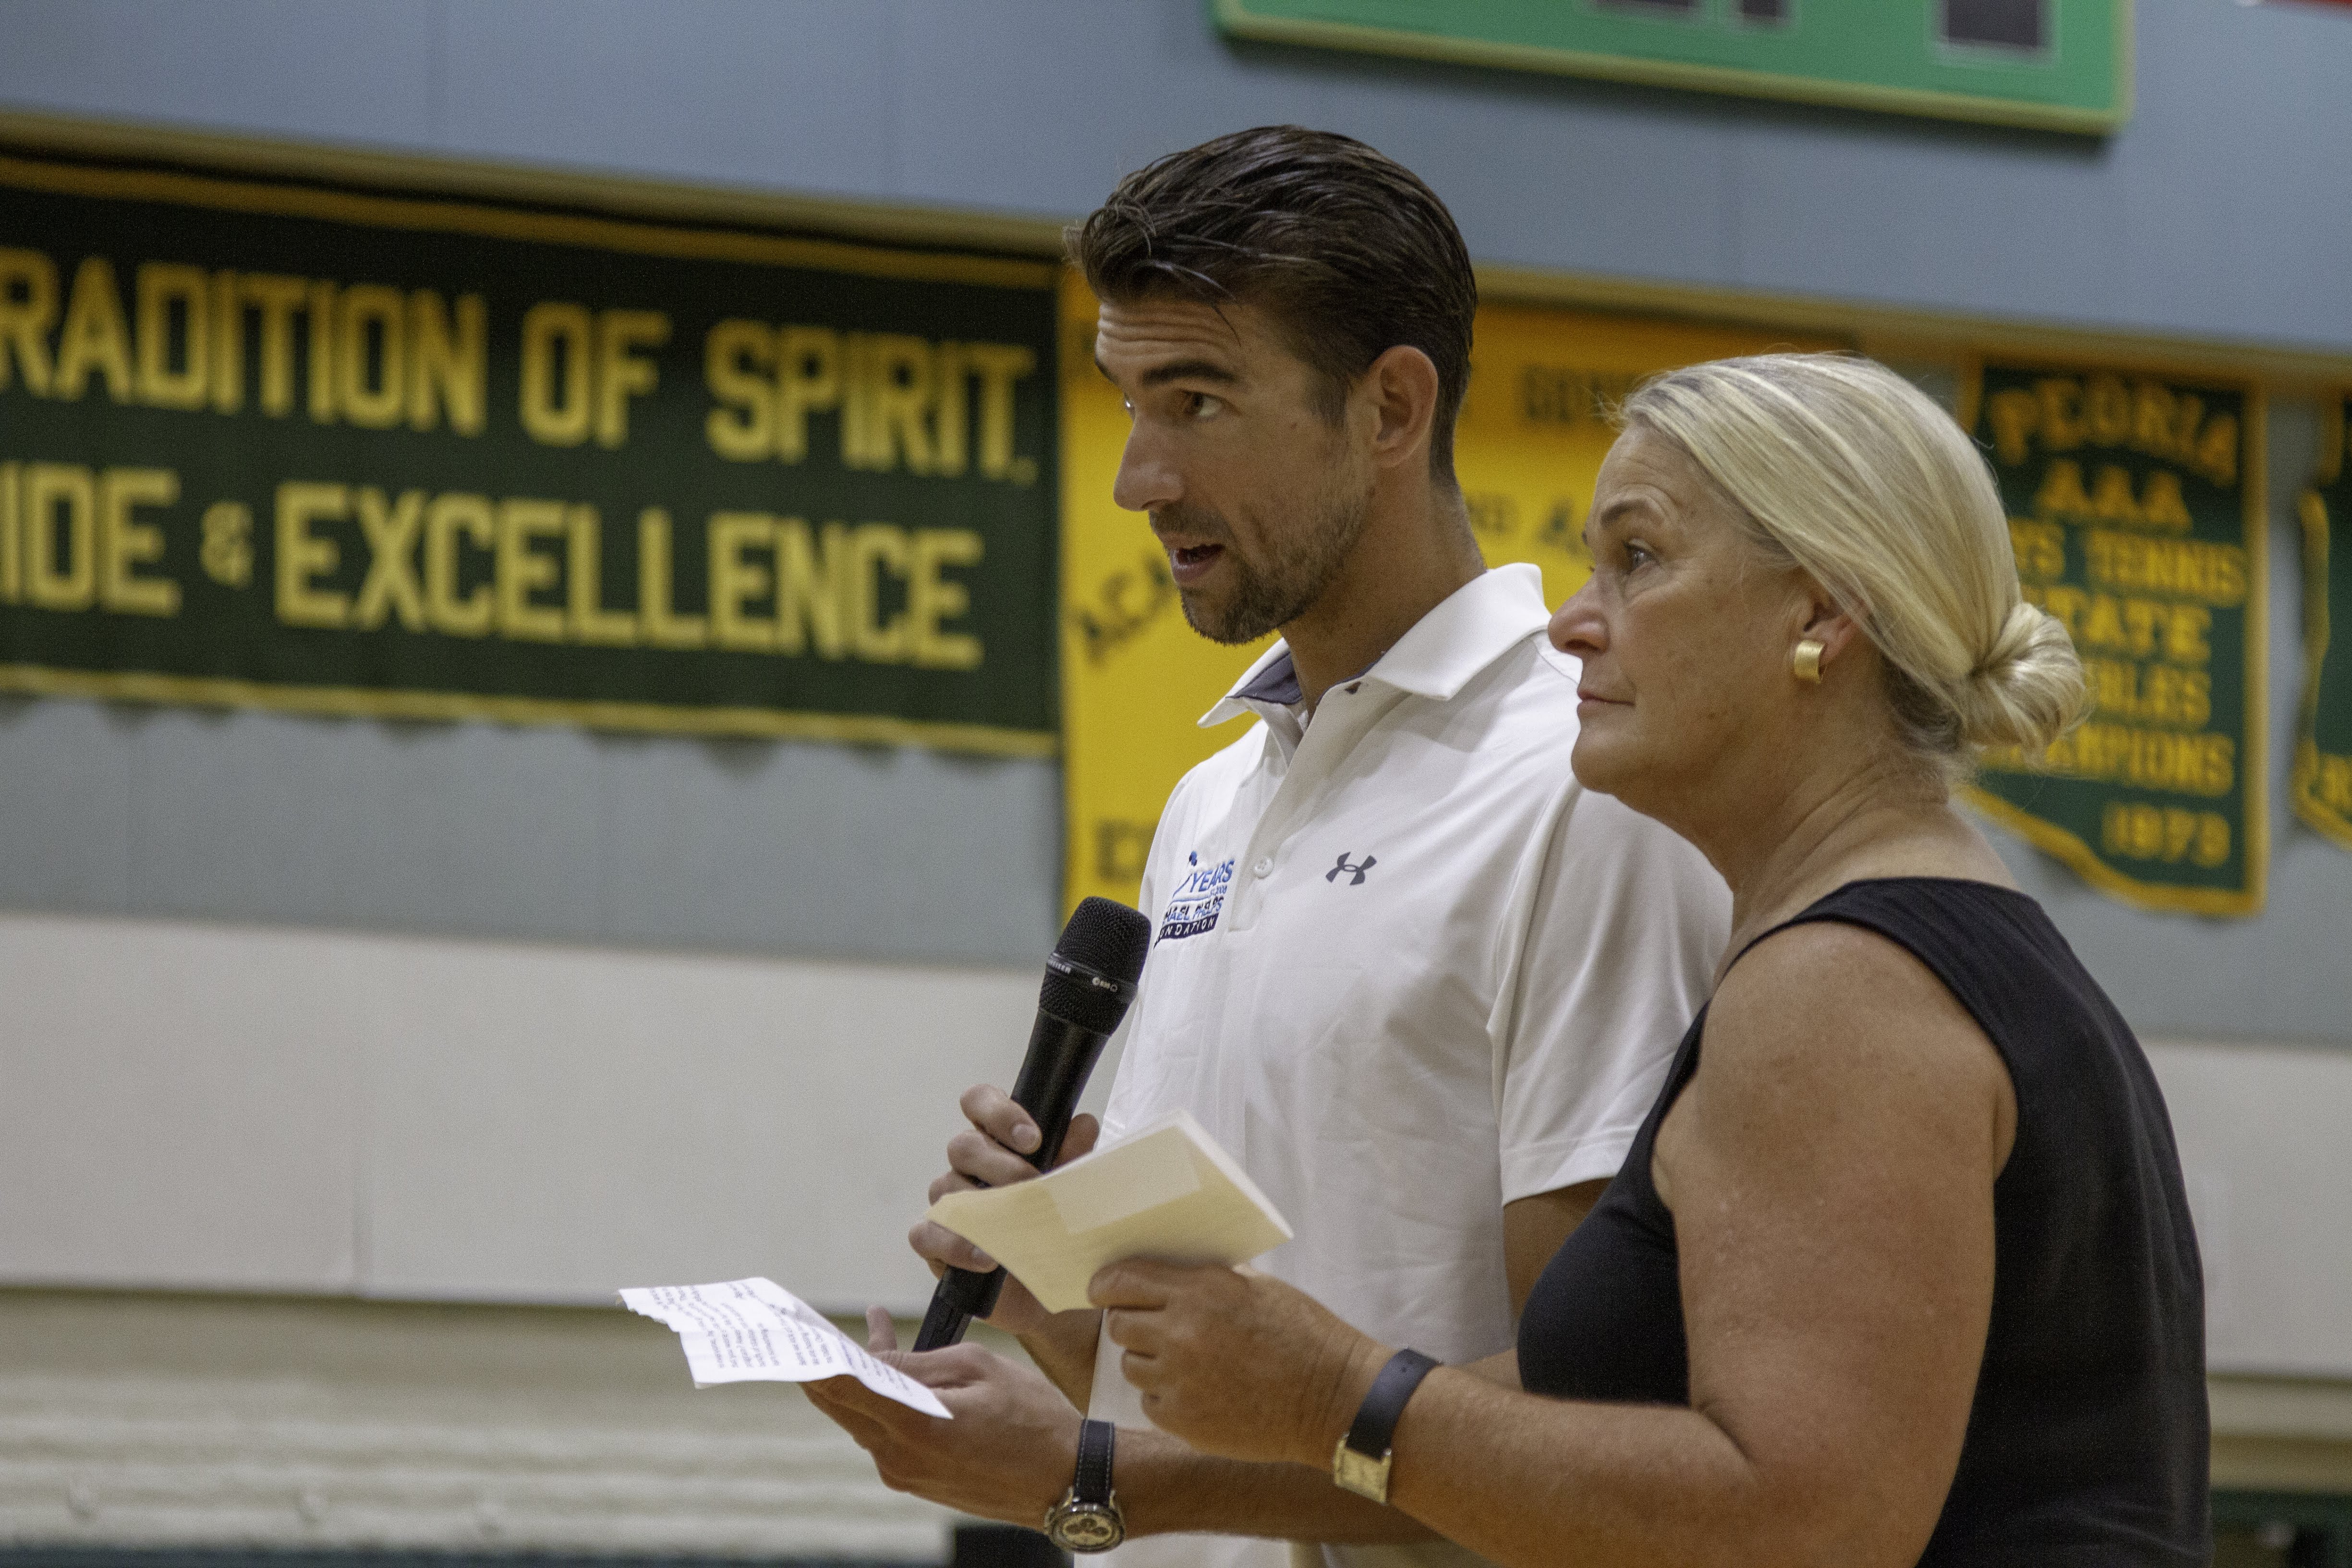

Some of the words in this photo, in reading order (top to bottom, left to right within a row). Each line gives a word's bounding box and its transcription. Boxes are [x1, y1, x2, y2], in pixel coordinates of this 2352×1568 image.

[520, 303, 670, 450] OF
[1989, 378, 2240, 487] PEORIA
[2037, 460, 2193, 531] AAA
[199, 500, 254, 589] &
[274, 480, 983, 669] EXCELLENCE
[2087, 529, 2247, 607] TENNIS
[2024, 585, 2212, 664] TATE
[1190, 858, 1235, 893] YEARS
